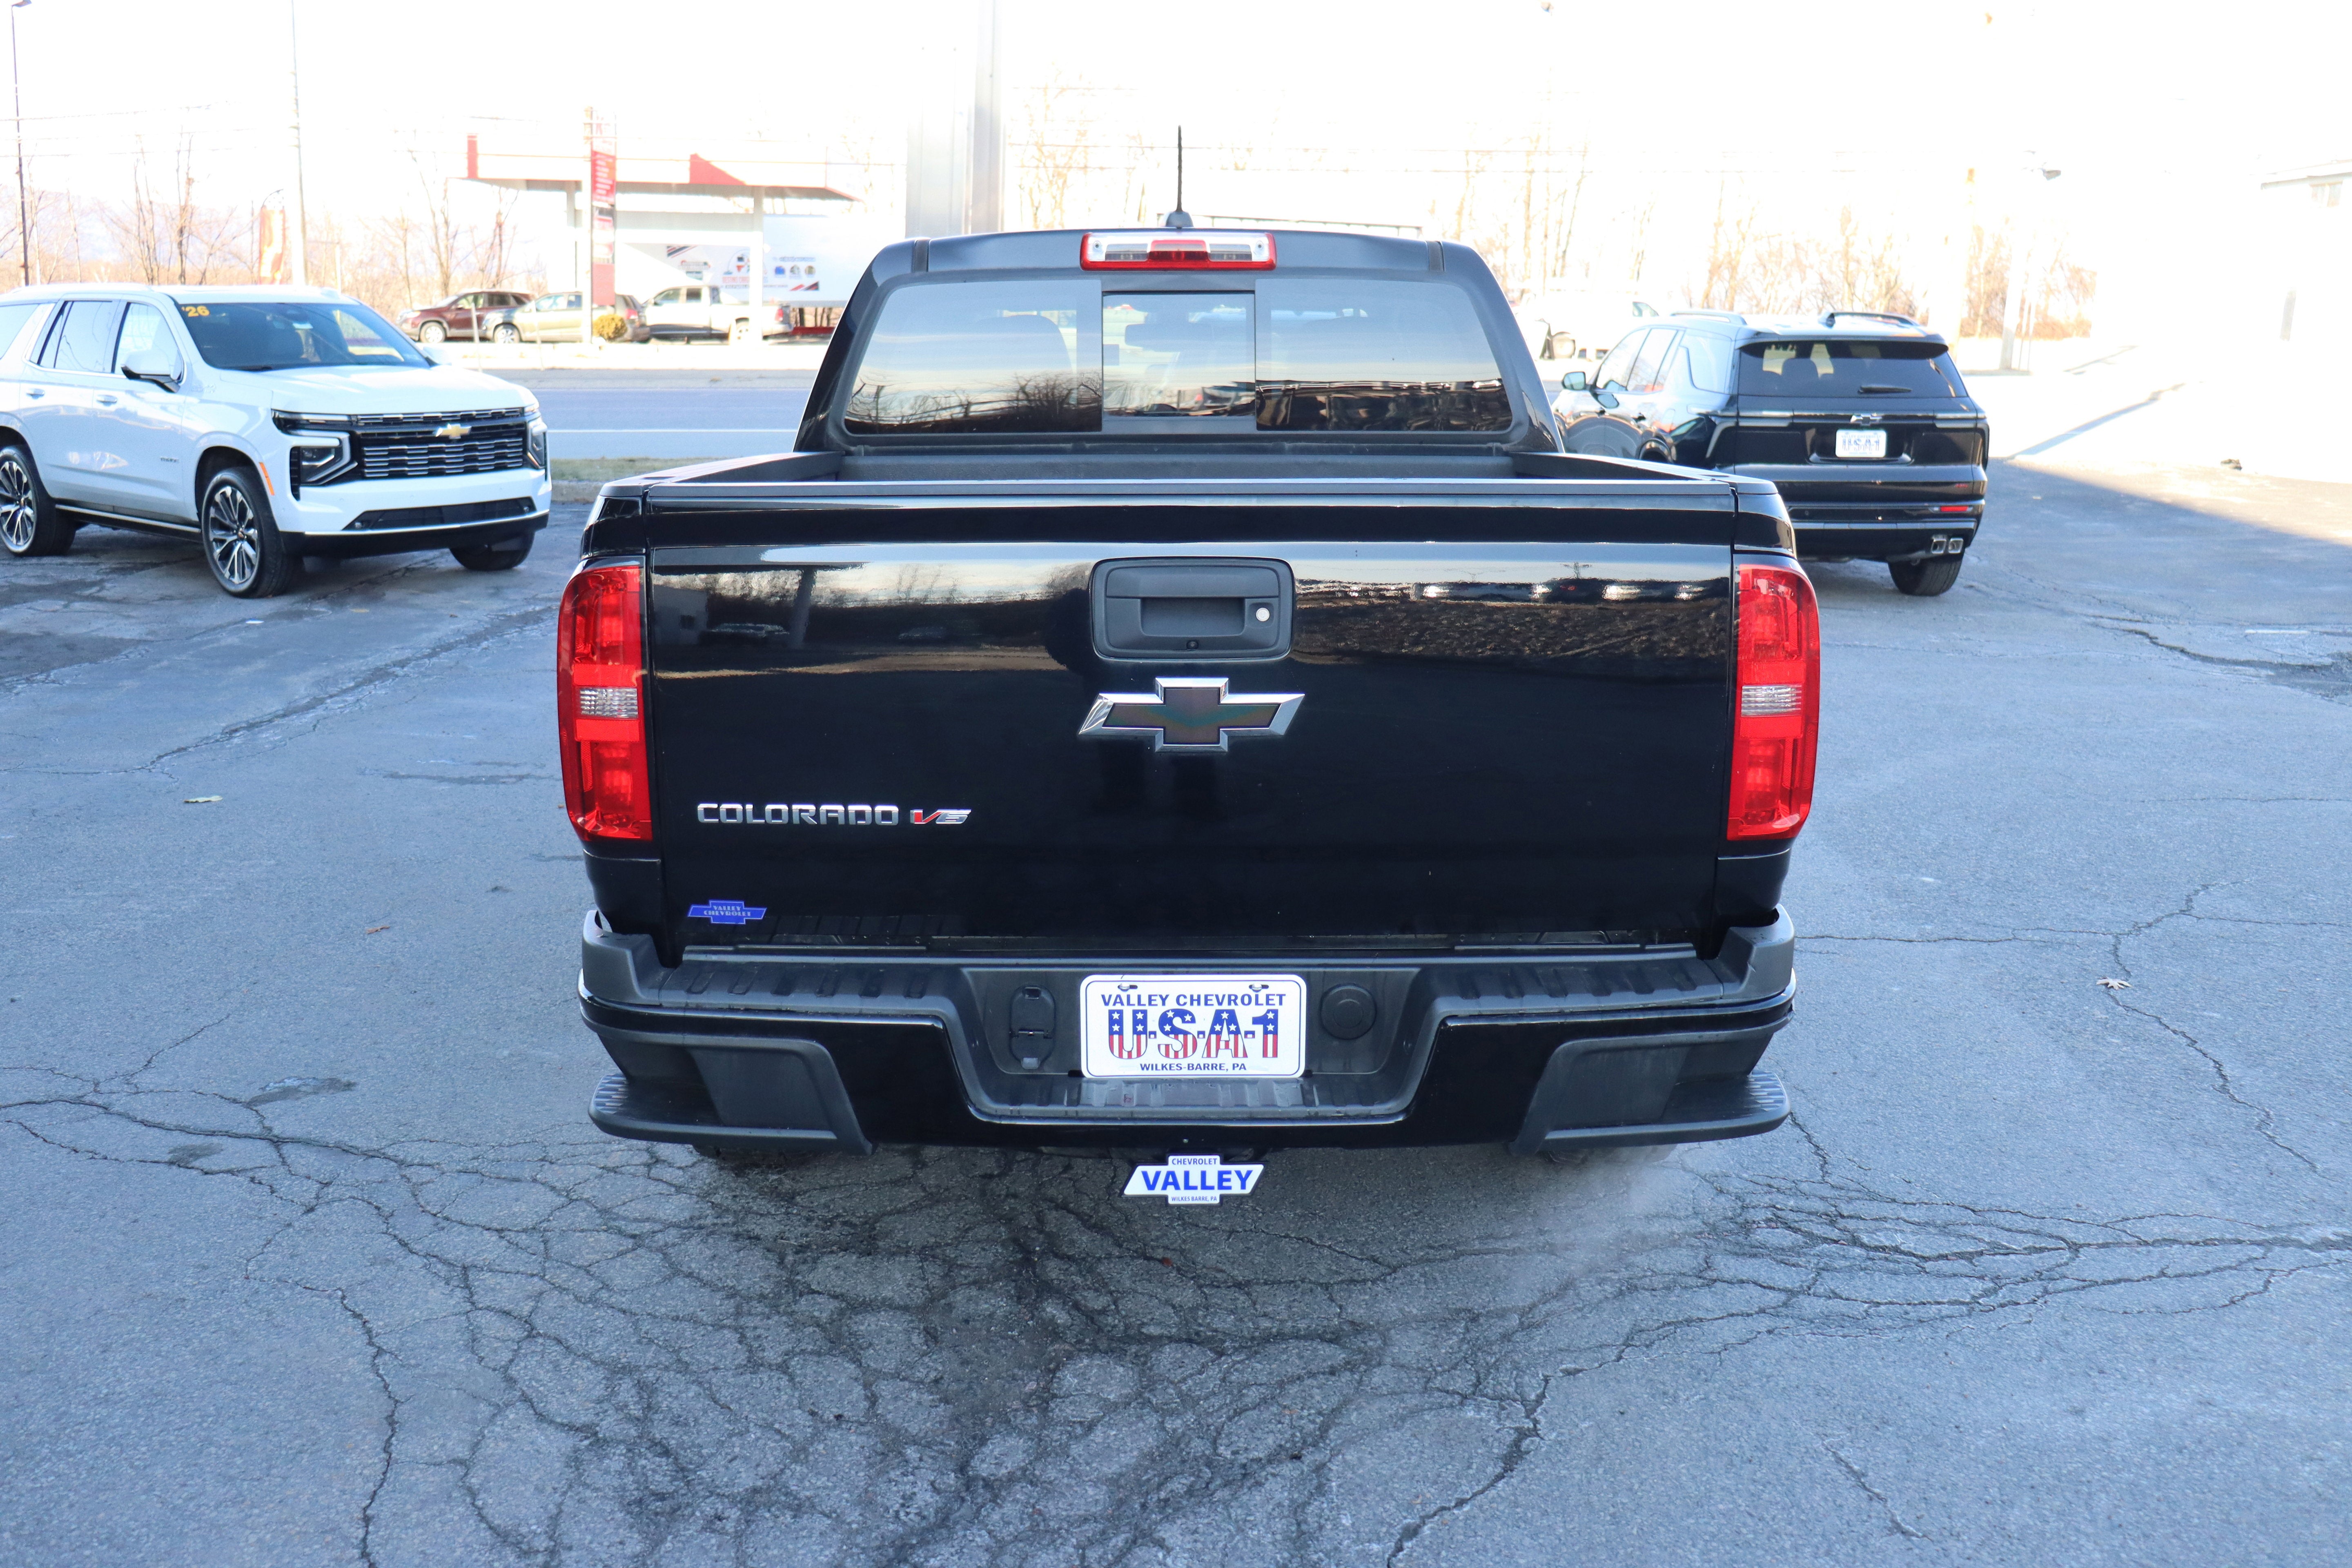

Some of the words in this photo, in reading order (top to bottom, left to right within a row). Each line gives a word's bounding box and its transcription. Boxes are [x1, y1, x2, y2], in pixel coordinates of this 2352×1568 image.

[697, 803, 899, 826] COLORADO
[910, 808, 972, 824] V6
[1101, 994, 1169, 1006] VALLEY
[1176, 993, 1286, 1006] CHEVROLET
[1140, 1063, 1229, 1072] WILKES-BARRE,
[1141, 1170, 1253, 1191] VALLEY
